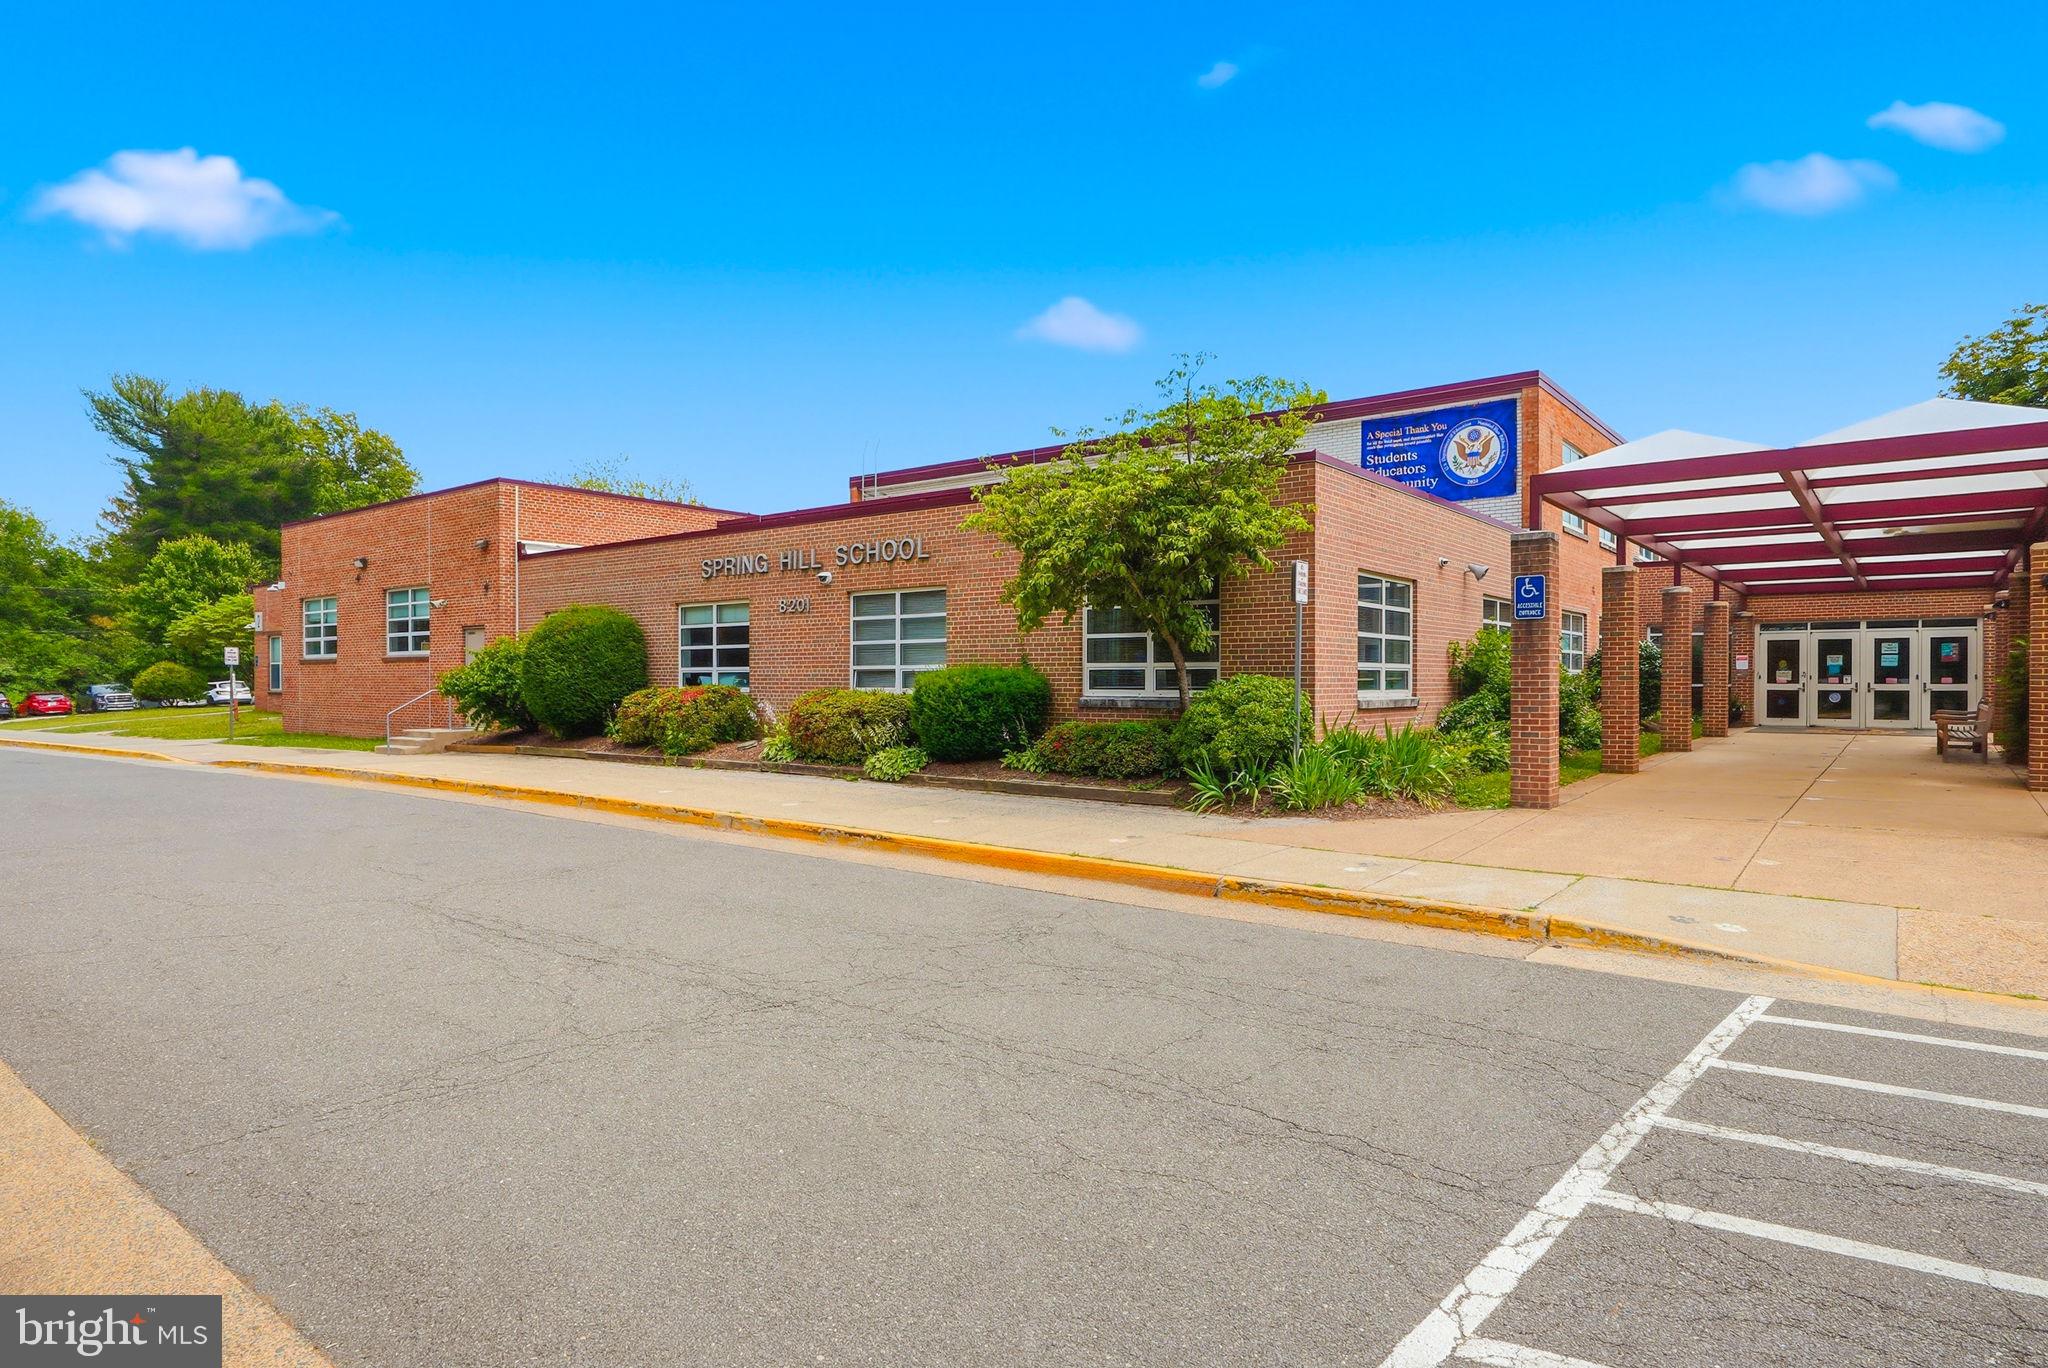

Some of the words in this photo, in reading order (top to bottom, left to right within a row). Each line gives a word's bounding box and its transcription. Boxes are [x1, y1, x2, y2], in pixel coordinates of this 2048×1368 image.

[1375, 428, 1402, 440] Special
[1406, 424, 1429, 434] Thank
[1431, 422, 1448, 432] You
[1366, 452, 1418, 466] Students
[701, 553, 768, 579] SPRING
[779, 548, 822, 571] HILL
[836, 537, 930, 566] SCHOOL
[778, 596, 810, 614] 8201
